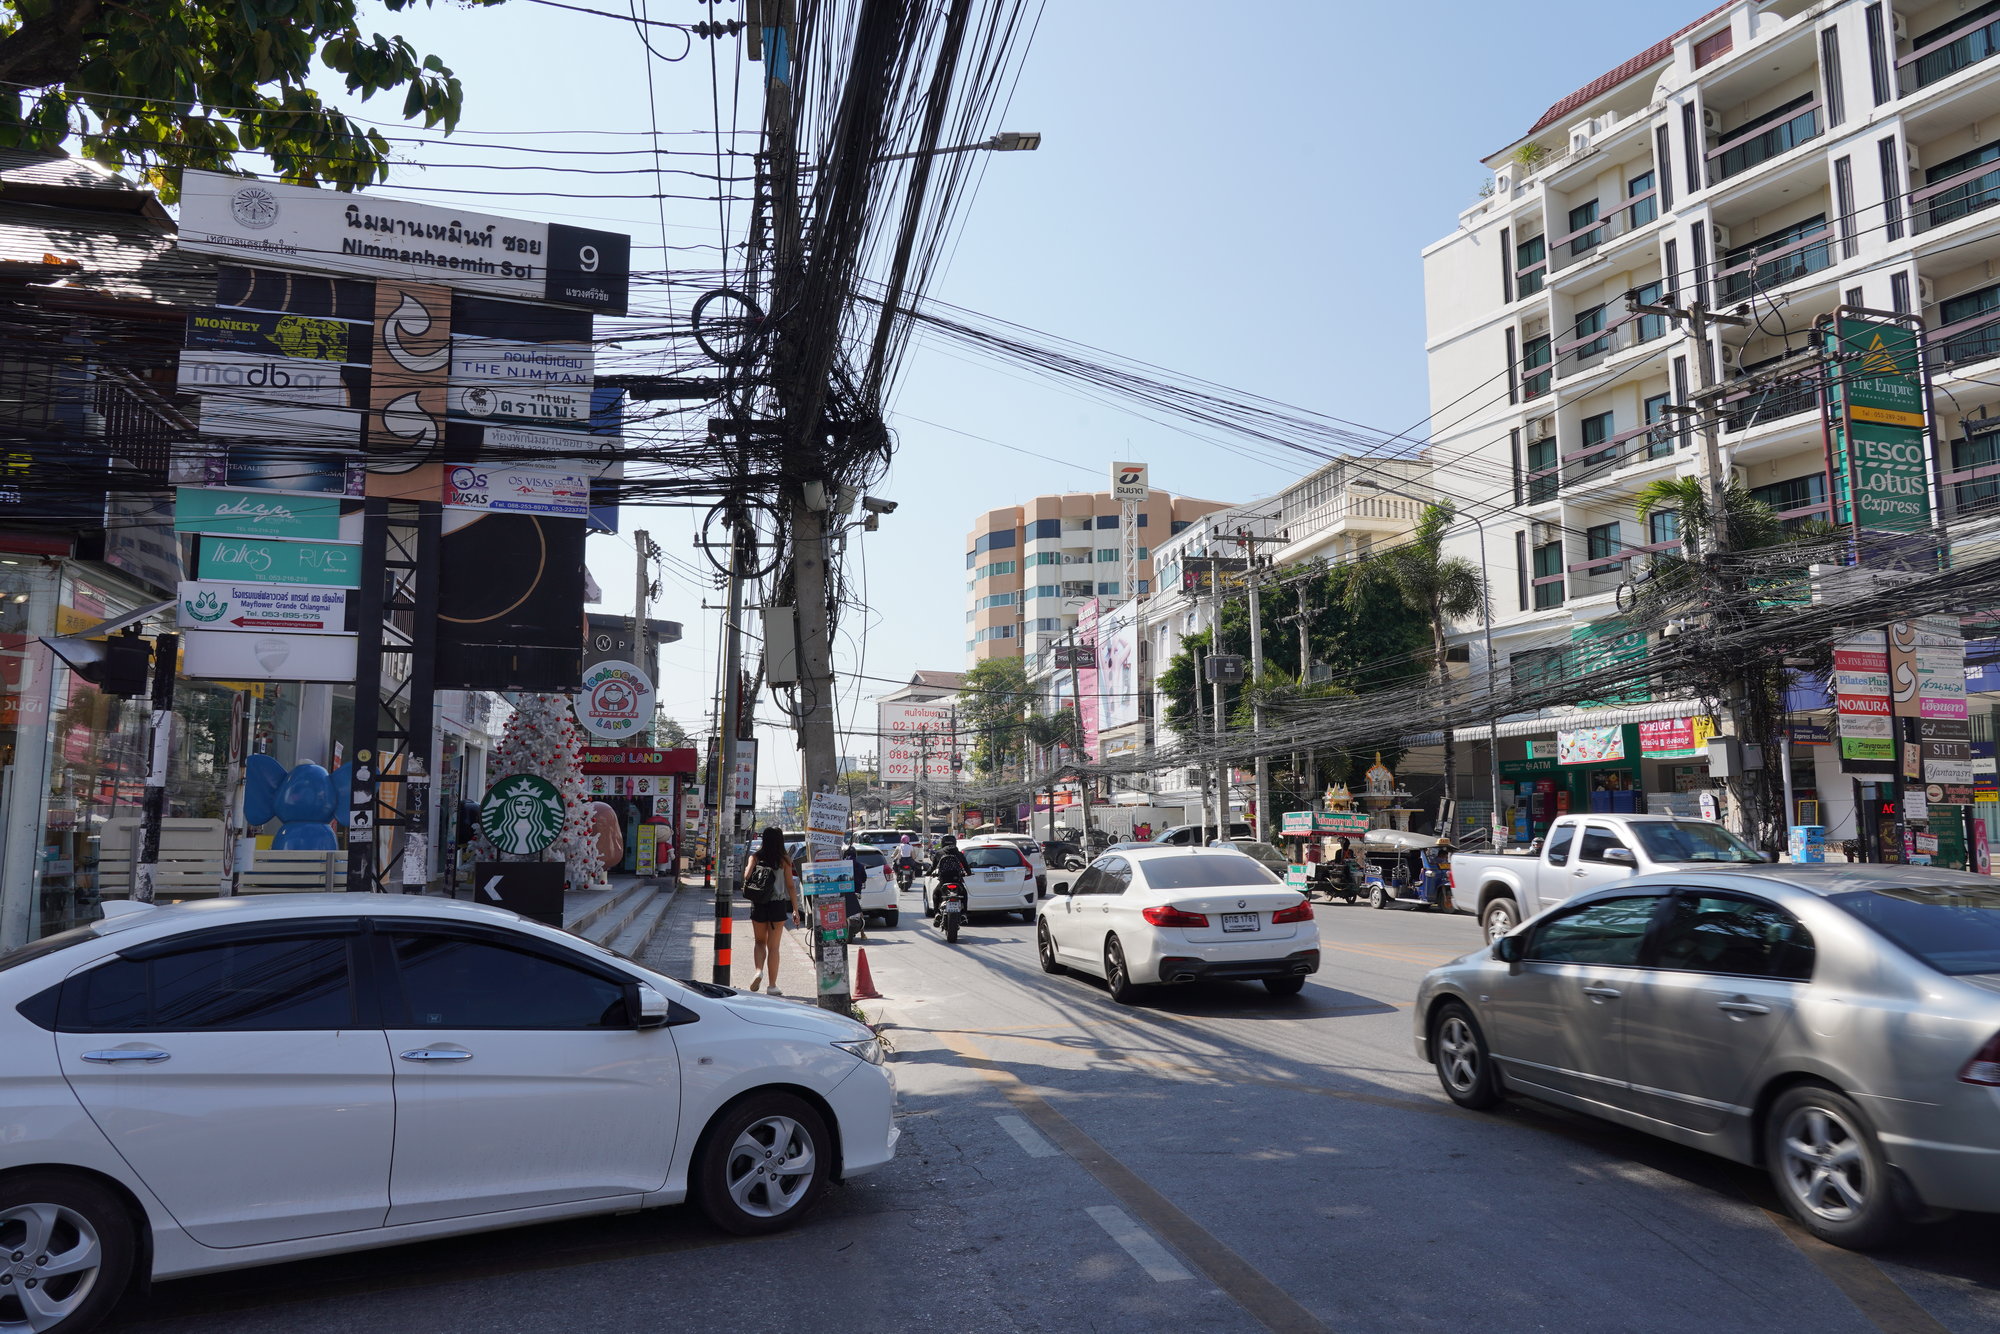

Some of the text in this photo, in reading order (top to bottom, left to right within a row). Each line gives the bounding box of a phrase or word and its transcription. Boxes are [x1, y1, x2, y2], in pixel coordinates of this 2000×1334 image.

[345, 204, 541, 256] นิมมานเหมินท์ ซอย
[343, 237, 496, 275] Nimmanhaemin
[579, 245, 599, 273] 9
[565, 287, 610, 302] แขวงศรีวิชัย
[195, 316, 261, 333] MONKEY
[503, 350, 584, 370] คอนโดมิเนียม
[192, 362, 326, 393] madbar
[461, 361, 587, 384] THE NIMMAN
[1852, 375, 1914, 398] The Empire
[501, 399, 578, 418] ตราแพะ
[1854, 439, 1923, 464] TESCO
[508, 476, 523, 486] OS
[526, 477, 554, 488] VISAS
[1856, 466, 1925, 495] Lotus
[452, 492, 488, 504] VISAS
[495, 501, 506, 509] Tel.
[1860, 493, 1920, 515] express
[211, 542, 272, 572] Italics
[241, 600, 331, 612] Mayflower Grande Chiangmai
[246, 610, 259, 618] Tel.
[583, 667, 650, 696] Taokaenoi
[1839, 699, 1890, 712] NOMURA
[596, 718, 632, 730] LAND
[1794, 732, 1809, 740] Express
[1858, 742, 1891, 753] Playground
[628, 752, 663, 764] LAND
[1533, 761, 1551, 770] ATM
